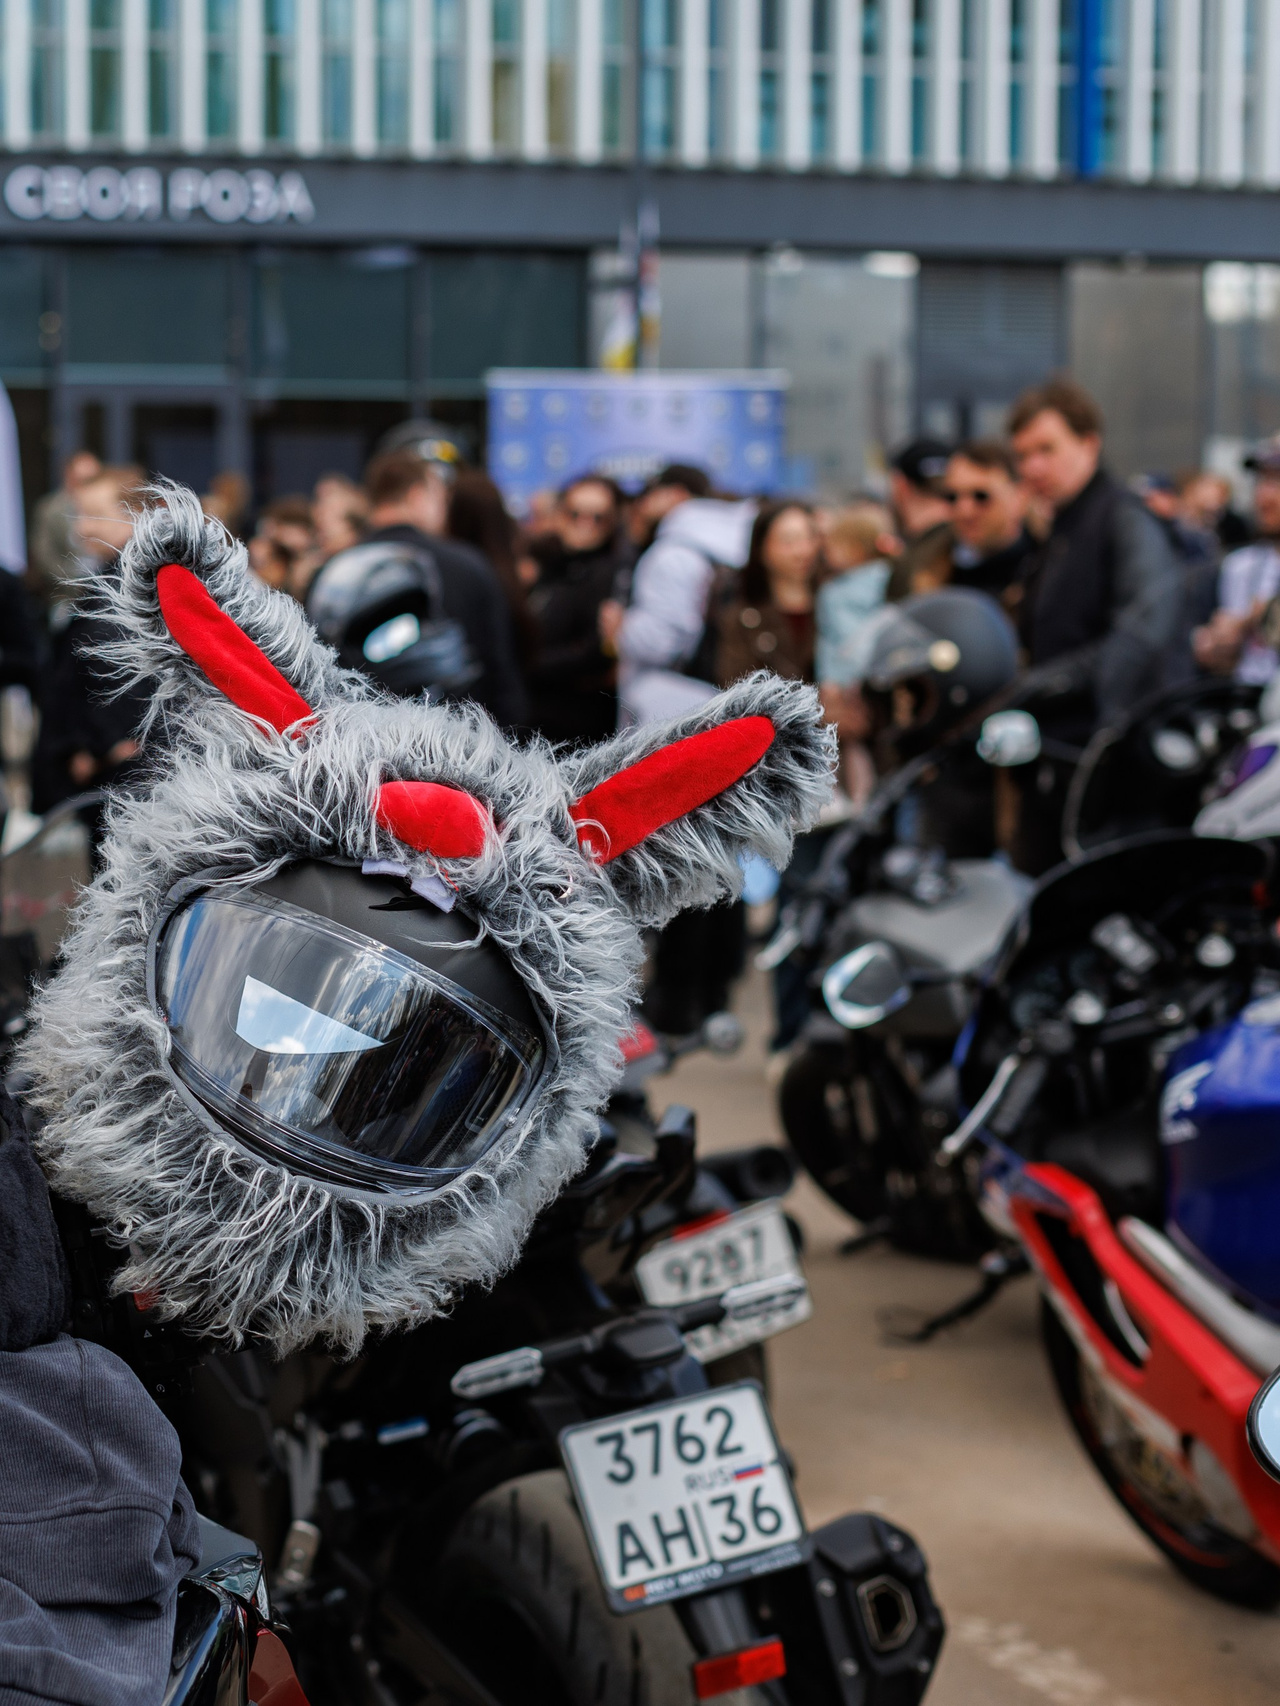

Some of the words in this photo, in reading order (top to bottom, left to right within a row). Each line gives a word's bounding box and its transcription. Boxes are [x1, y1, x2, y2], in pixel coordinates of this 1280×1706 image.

[4, 165, 162, 222] СВОЯ
[167, 167, 315, 224] РОЗА
[664, 1227, 764, 1294] 9287
[596, 1406, 745, 1485] 3762
[684, 1470, 734, 1494] RUS
[709, 1484, 783, 1546] 36
